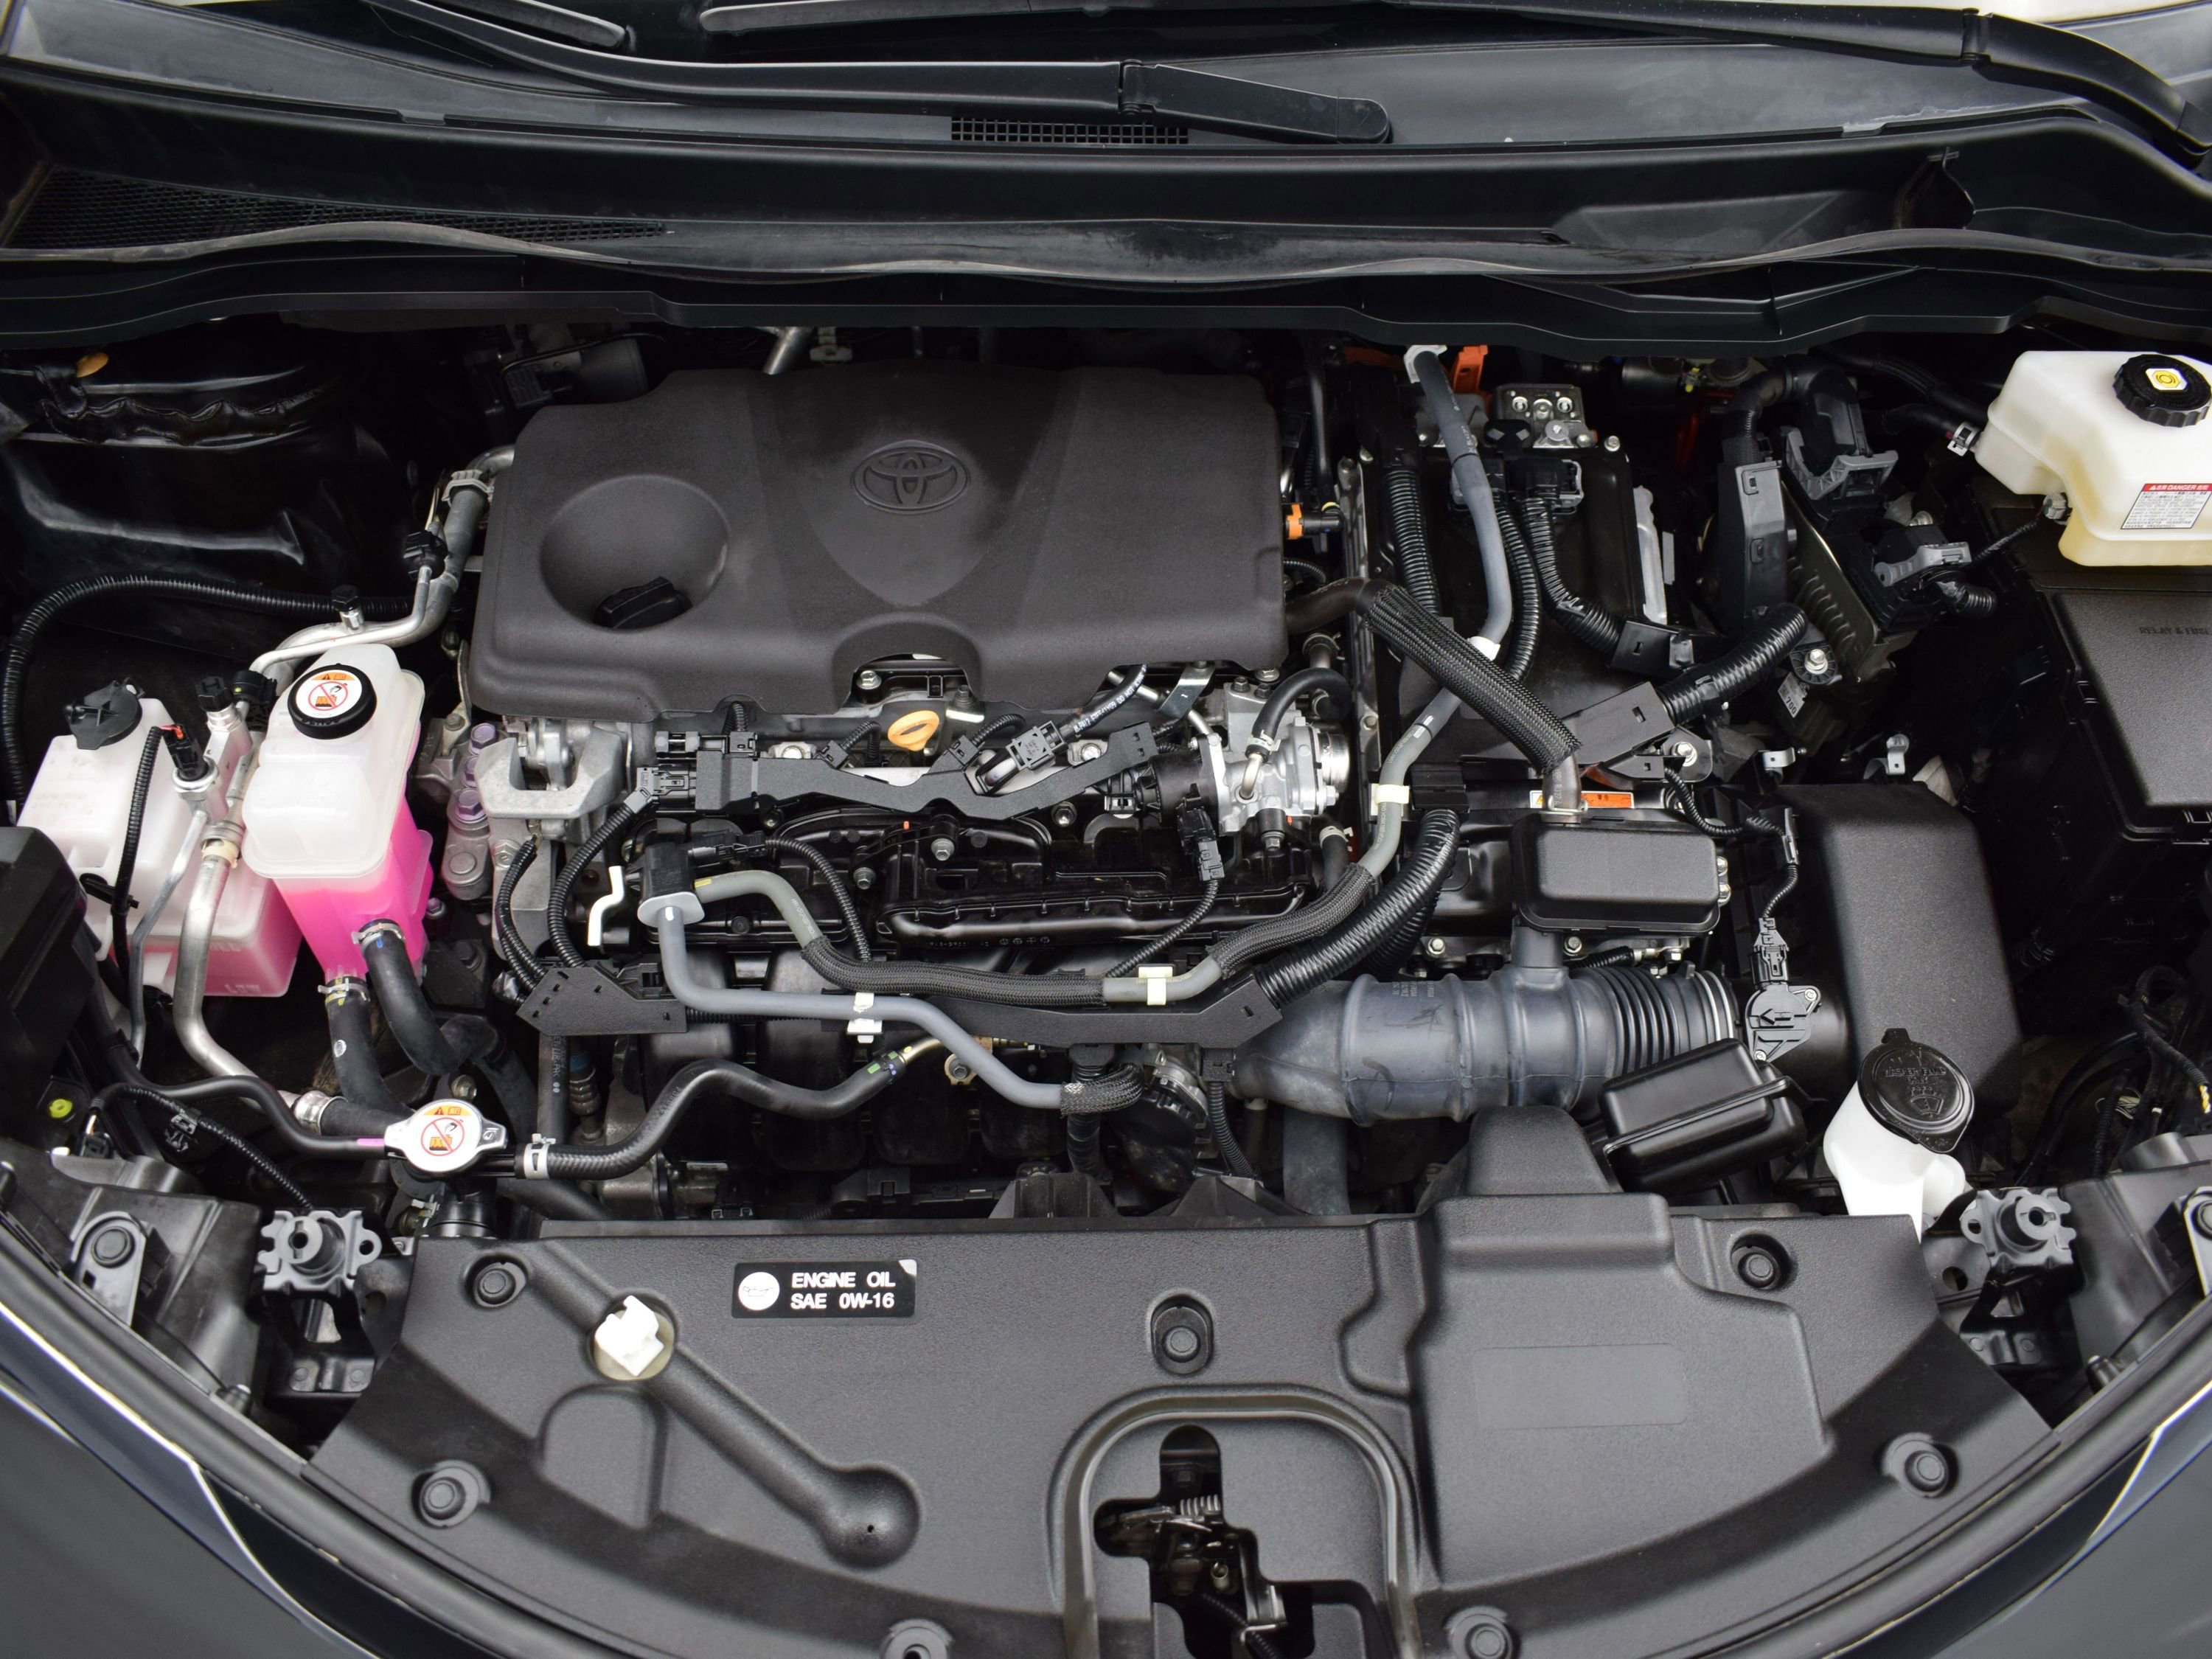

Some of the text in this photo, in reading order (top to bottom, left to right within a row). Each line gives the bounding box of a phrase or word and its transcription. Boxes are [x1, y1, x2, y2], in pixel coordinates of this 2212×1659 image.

[1786, 696, 1798, 714] 700
[791, 1271, 896, 1288] ENGINE OIL
[790, 1293, 895, 1310] SAE 0W-16
